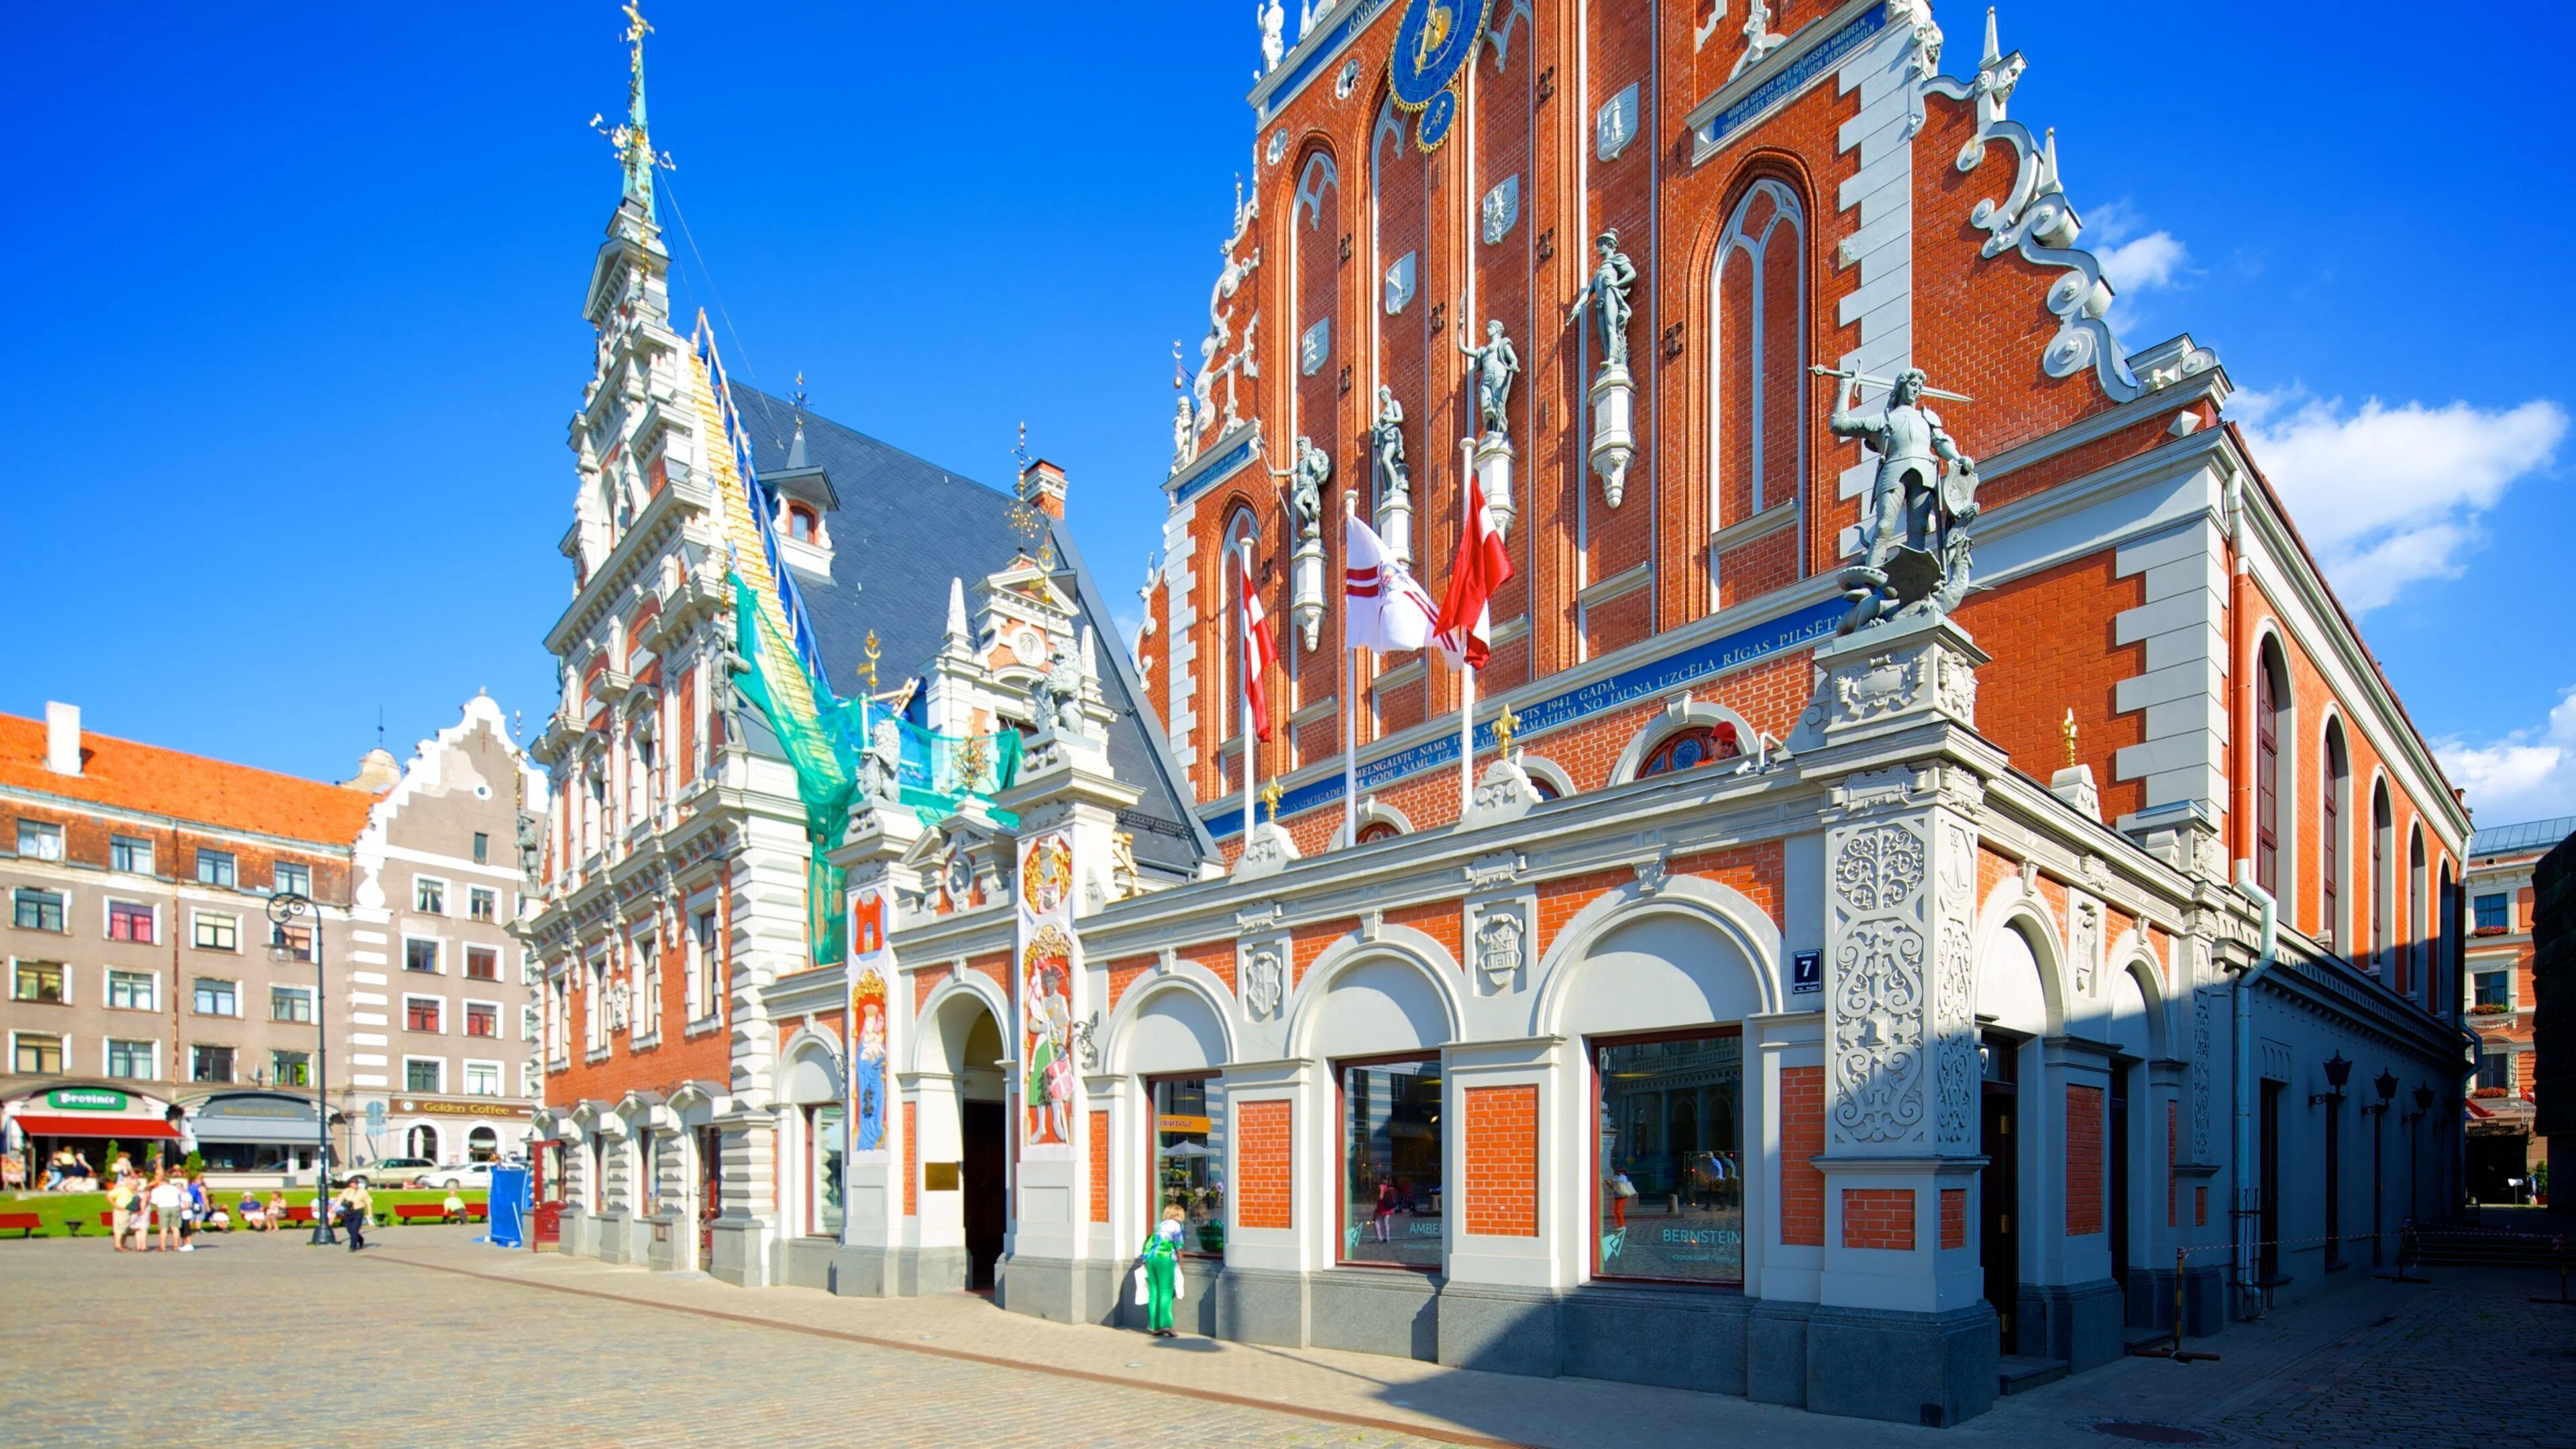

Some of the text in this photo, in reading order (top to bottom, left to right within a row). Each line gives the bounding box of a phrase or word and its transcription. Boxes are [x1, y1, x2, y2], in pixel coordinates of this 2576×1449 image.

[1722, 117, 1737, 133] THUT
[1740, 100, 1764, 122] GOTTES
[1766, 84, 1788, 105] SEGEN
[1800, 58, 1823, 80] LUCH
[1825, 23, 1874, 63] VERWANDELN
[1727, 99, 1749, 119] WIDER
[1751, 80, 1774, 103] GESETZ
[1369, 768, 1397, 785] GODU
[1401, 756, 1432, 773] NAMU
[1438, 749, 1452, 761] UZ
[1515, 706, 1576, 735] PAMATIEM
[1583, 698, 1603, 712] NO
[1611, 682, 1652, 704] JAUNA
[1659, 659, 1715, 687] UZCĒLA
[1723, 640, 1770, 665] RĪGAS
[1419, 740, 1447, 757] NAMS
[1547, 696, 1573, 712] 1941.
[1801, 960, 1812, 977] 7
[423, 1102, 510, 1116] Golden Coffee
[1663, 1229, 1741, 1244] BERNSTEIN
